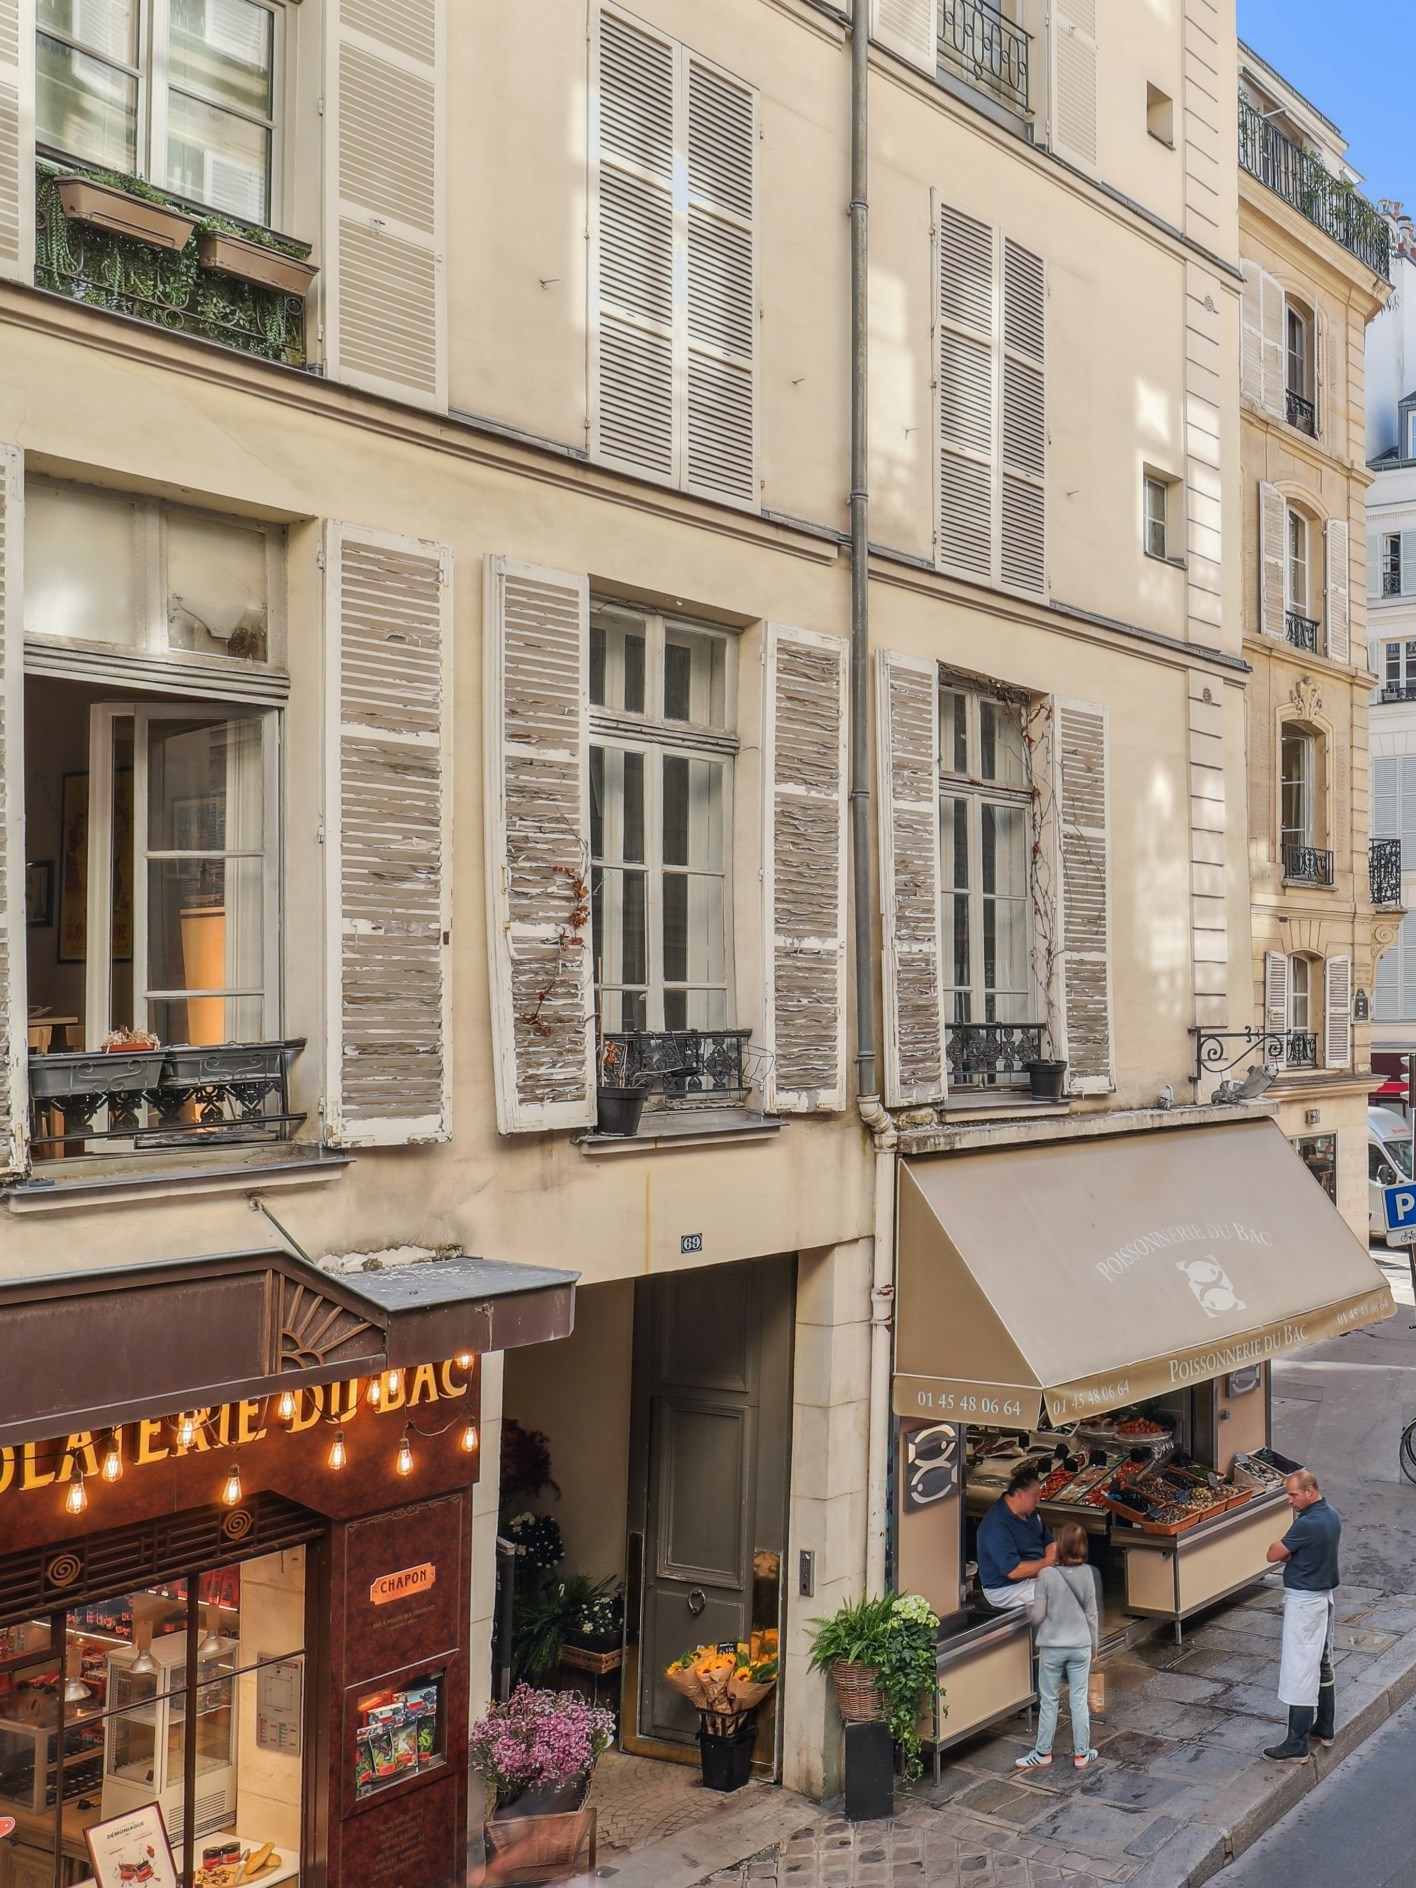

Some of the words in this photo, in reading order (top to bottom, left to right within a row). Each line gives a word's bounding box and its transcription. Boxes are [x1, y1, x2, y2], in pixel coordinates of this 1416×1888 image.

[1395, 1192, 1415, 1221] P
[684, 1236, 701, 1250] 69
[1095, 1224, 1206, 1284] POISSONNERIE
[1168, 1337, 1261, 1383] POISSONNERIE
[286, 1378, 358, 1433] DU
[373, 1358, 468, 1414] BAC
[918, 1391, 933, 1407] 01
[938, 1394, 955, 1409] 45
[960, 1396, 976, 1412] 48
[981, 1397, 999, 1414] 06
[1003, 1400, 1021, 1416] 64
[1053, 1399, 1067, 1416] 01
[1071, 1393, 1085, 1410] 45
[1087, 1389, 1101, 1405] 48
[1101, 1384, 1115, 1401] 06
[1117, 1379, 1130, 1396] 64
[380, 1569, 427, 1594] CHAPON
